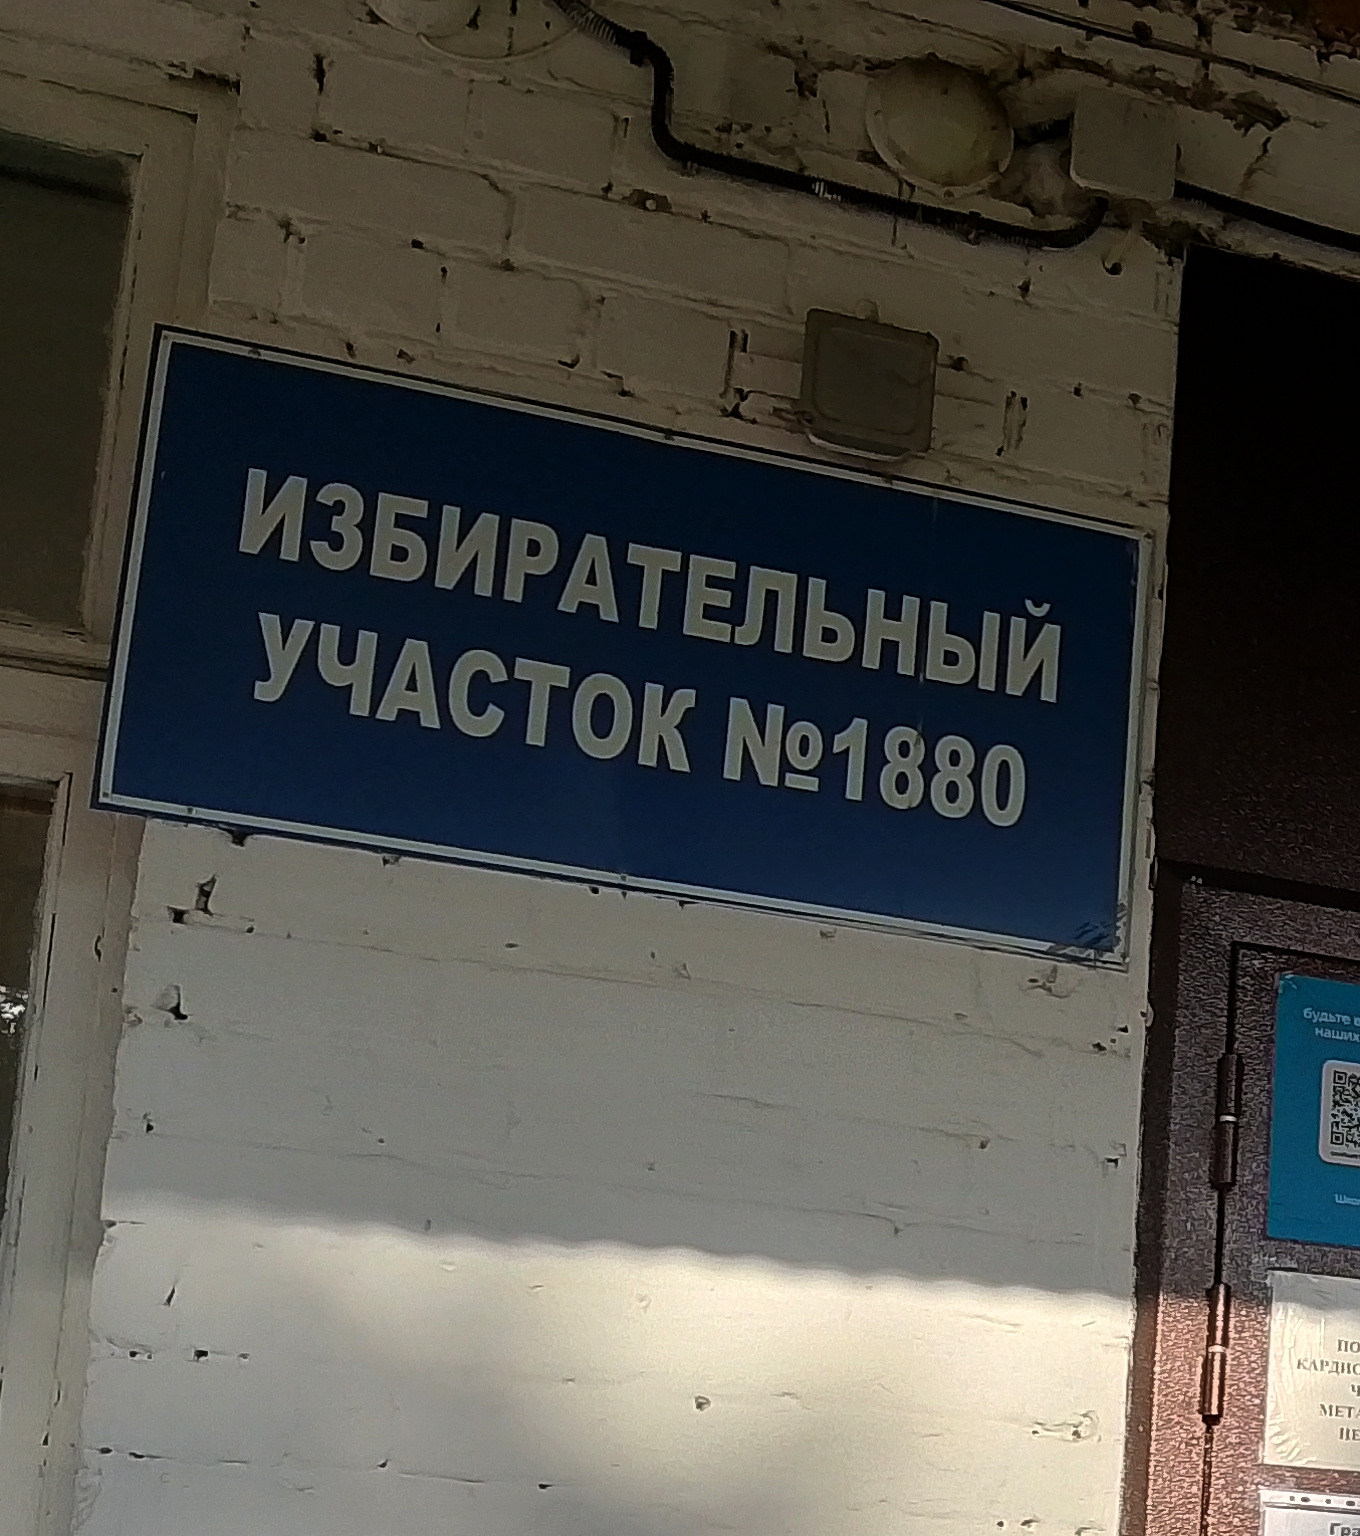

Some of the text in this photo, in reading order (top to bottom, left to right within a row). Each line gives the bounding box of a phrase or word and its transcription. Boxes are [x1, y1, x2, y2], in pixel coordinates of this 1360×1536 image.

[239, 467, 1061, 703] ИЗБИРАТЕЛЬНЫЙ
[253, 612, 1026, 827] УЧАСТОК №1880
[1303, 1007, 1351, 1025] будьте
[1315, 1027, 1360, 1043] наших
